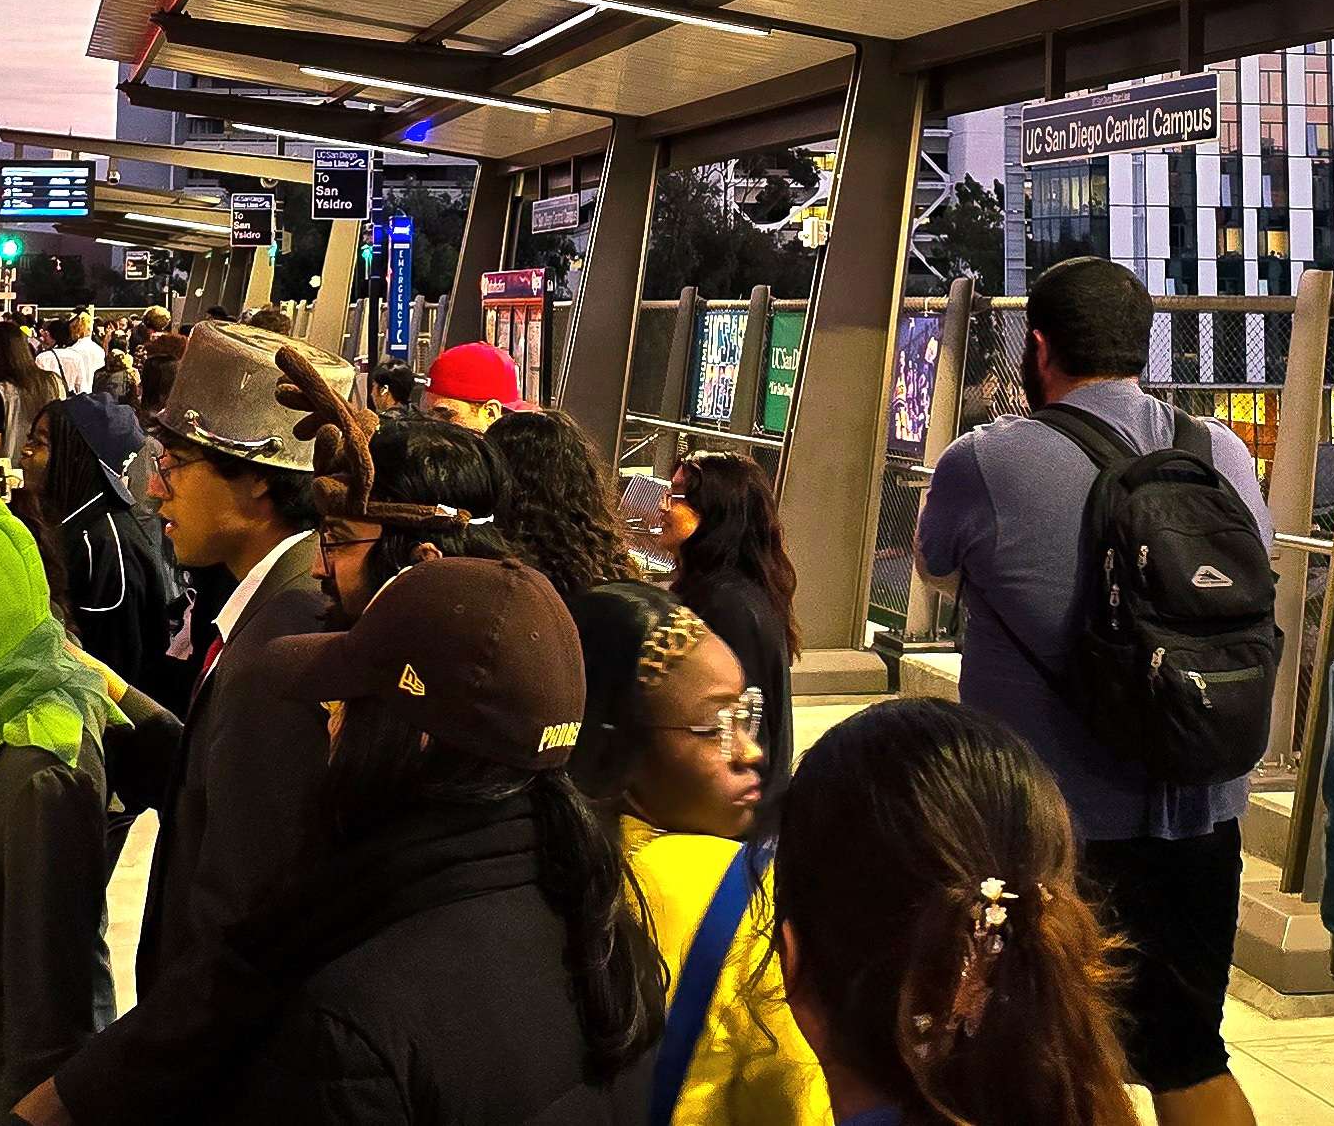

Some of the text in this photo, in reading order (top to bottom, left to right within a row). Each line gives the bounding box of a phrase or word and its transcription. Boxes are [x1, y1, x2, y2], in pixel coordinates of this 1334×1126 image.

[1026, 107, 1212, 156] UC San Diego Central Campus
[315, 172, 330, 183] To
[315, 185, 339, 196] San
[315, 198, 353, 209] Ysidro
[233, 211, 244, 220] To
[233, 220, 251, 230] San
[233, 230, 261, 239] Ysidro
[396, 249, 405, 328] EMERGENCY
